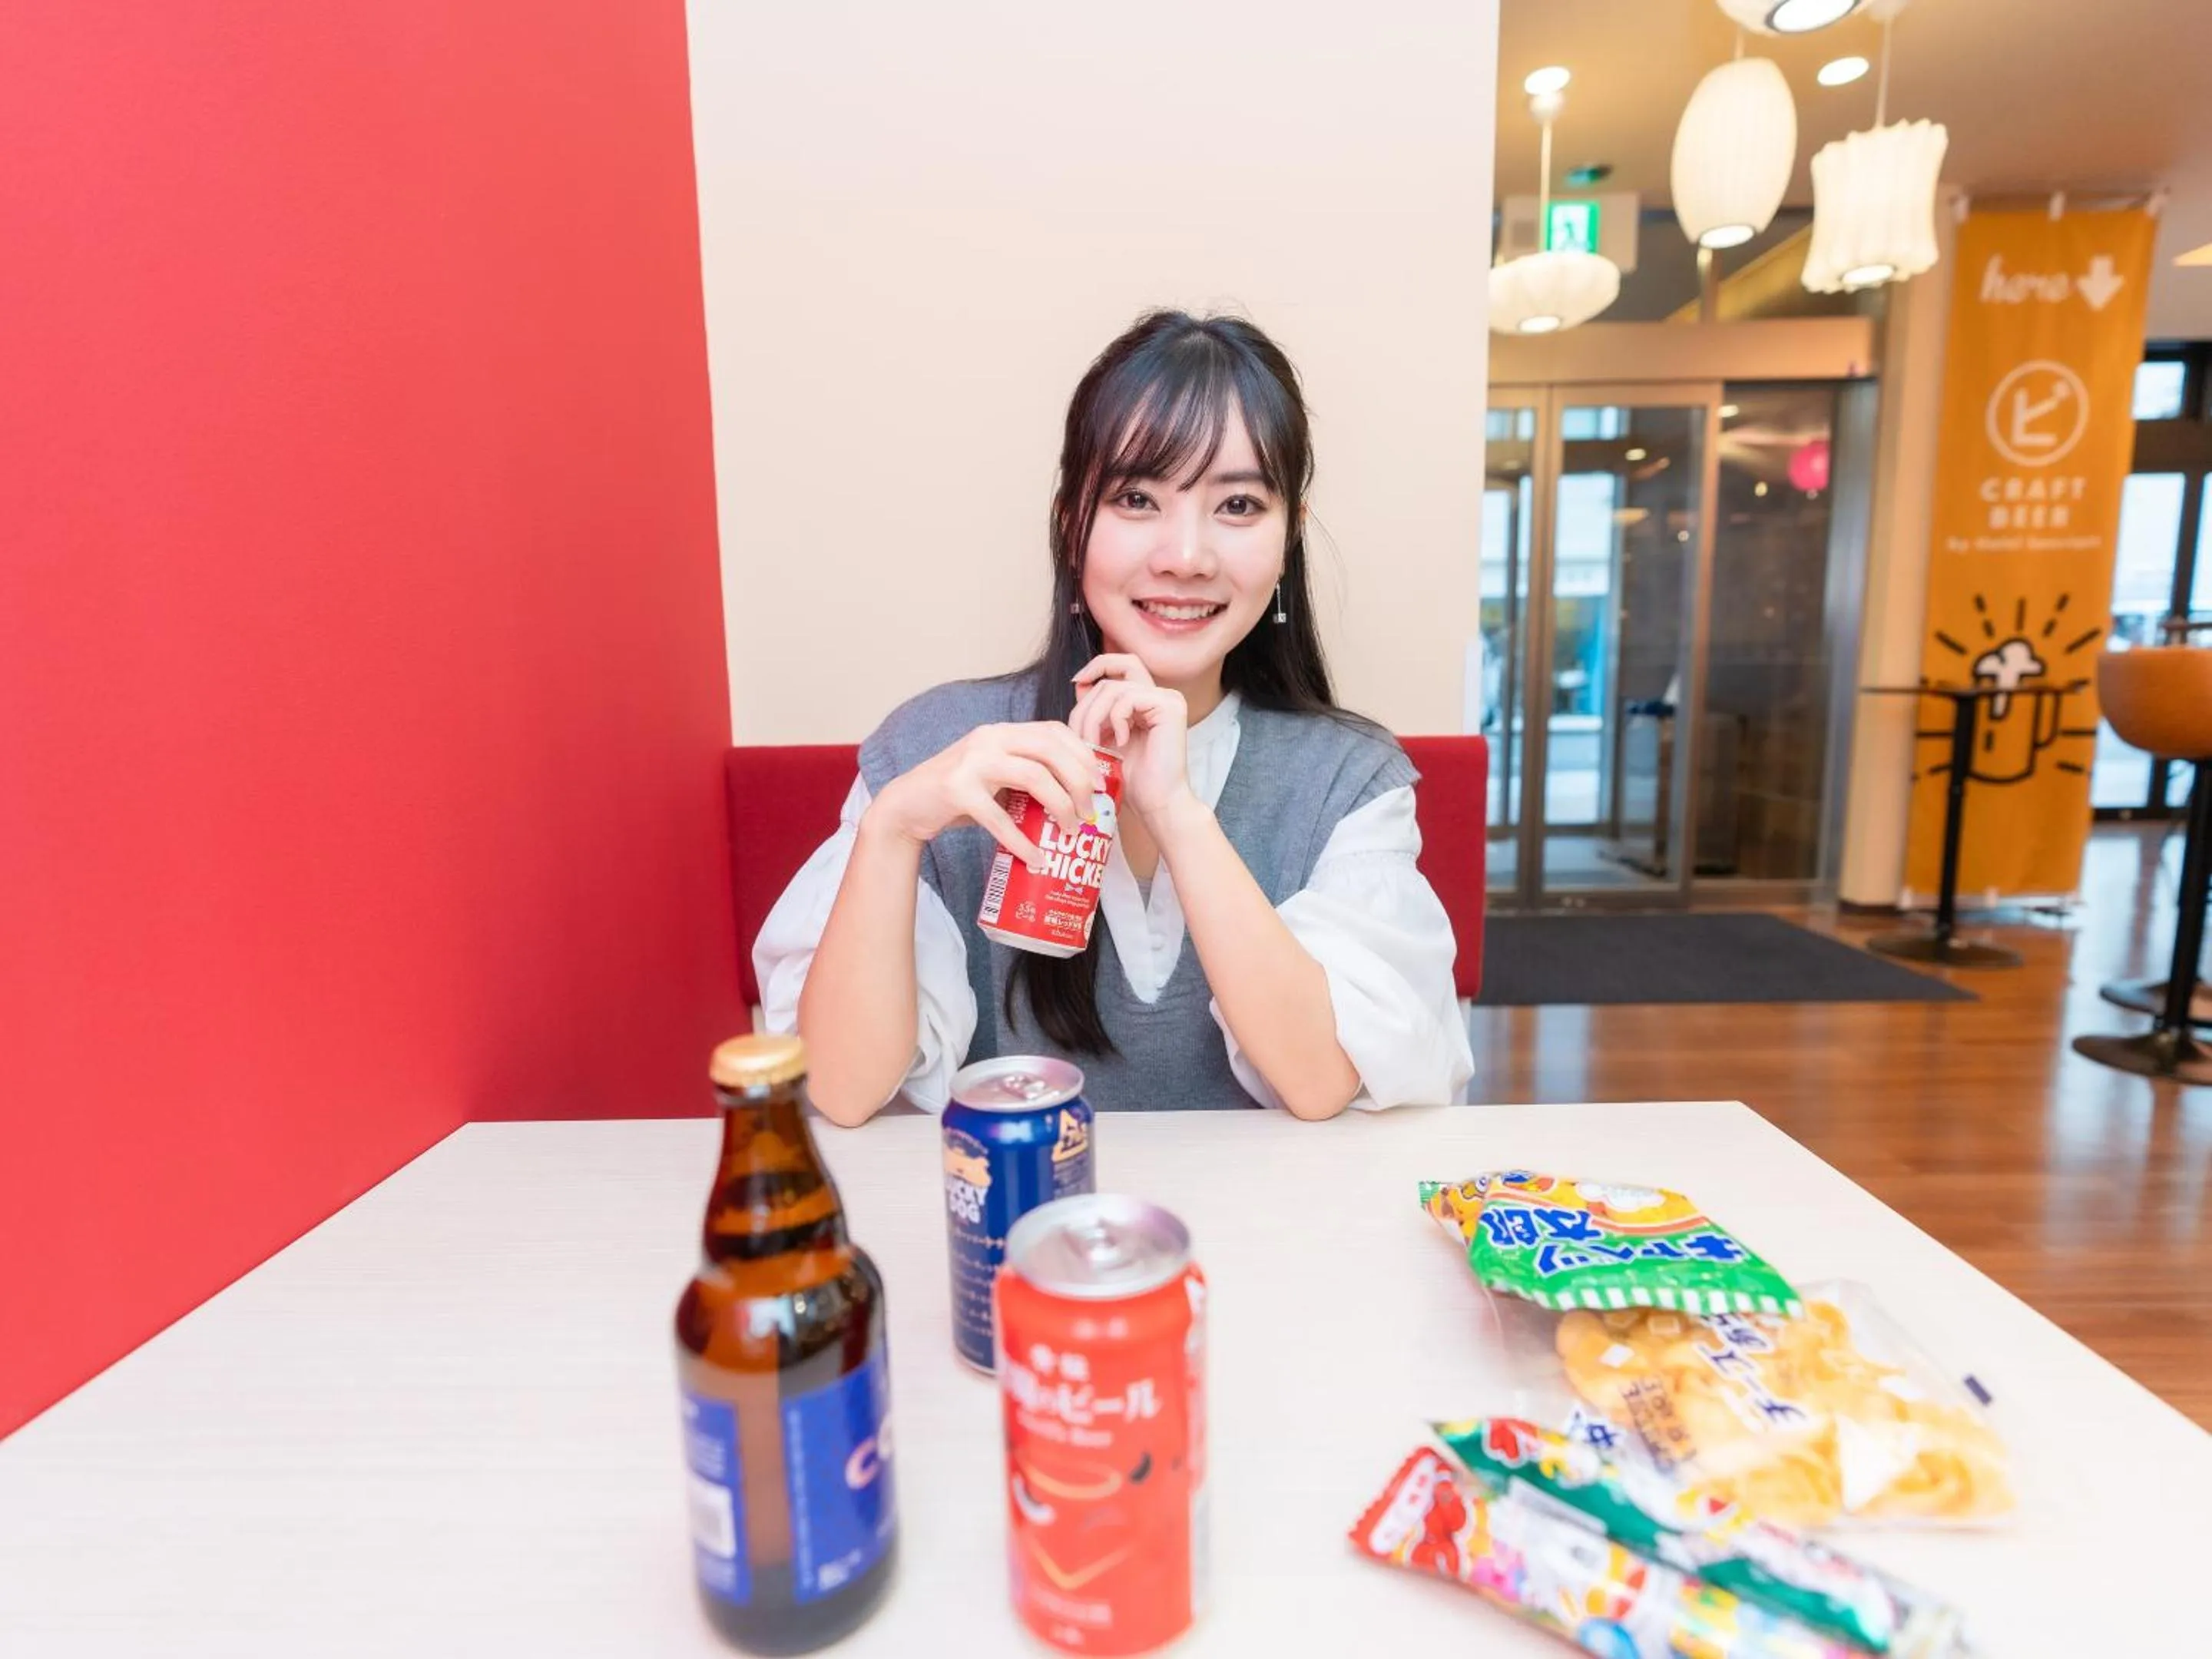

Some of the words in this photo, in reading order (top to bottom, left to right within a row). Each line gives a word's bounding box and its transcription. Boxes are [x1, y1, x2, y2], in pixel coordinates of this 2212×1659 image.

[1979, 475, 2087, 502] CRAFT
[1988, 504, 2070, 530] BEER
[1039, 822, 1112, 866] LUCKY
[1480, 1207, 1602, 1247] 太郎
[1535, 1231, 1746, 1275] キャベツ
